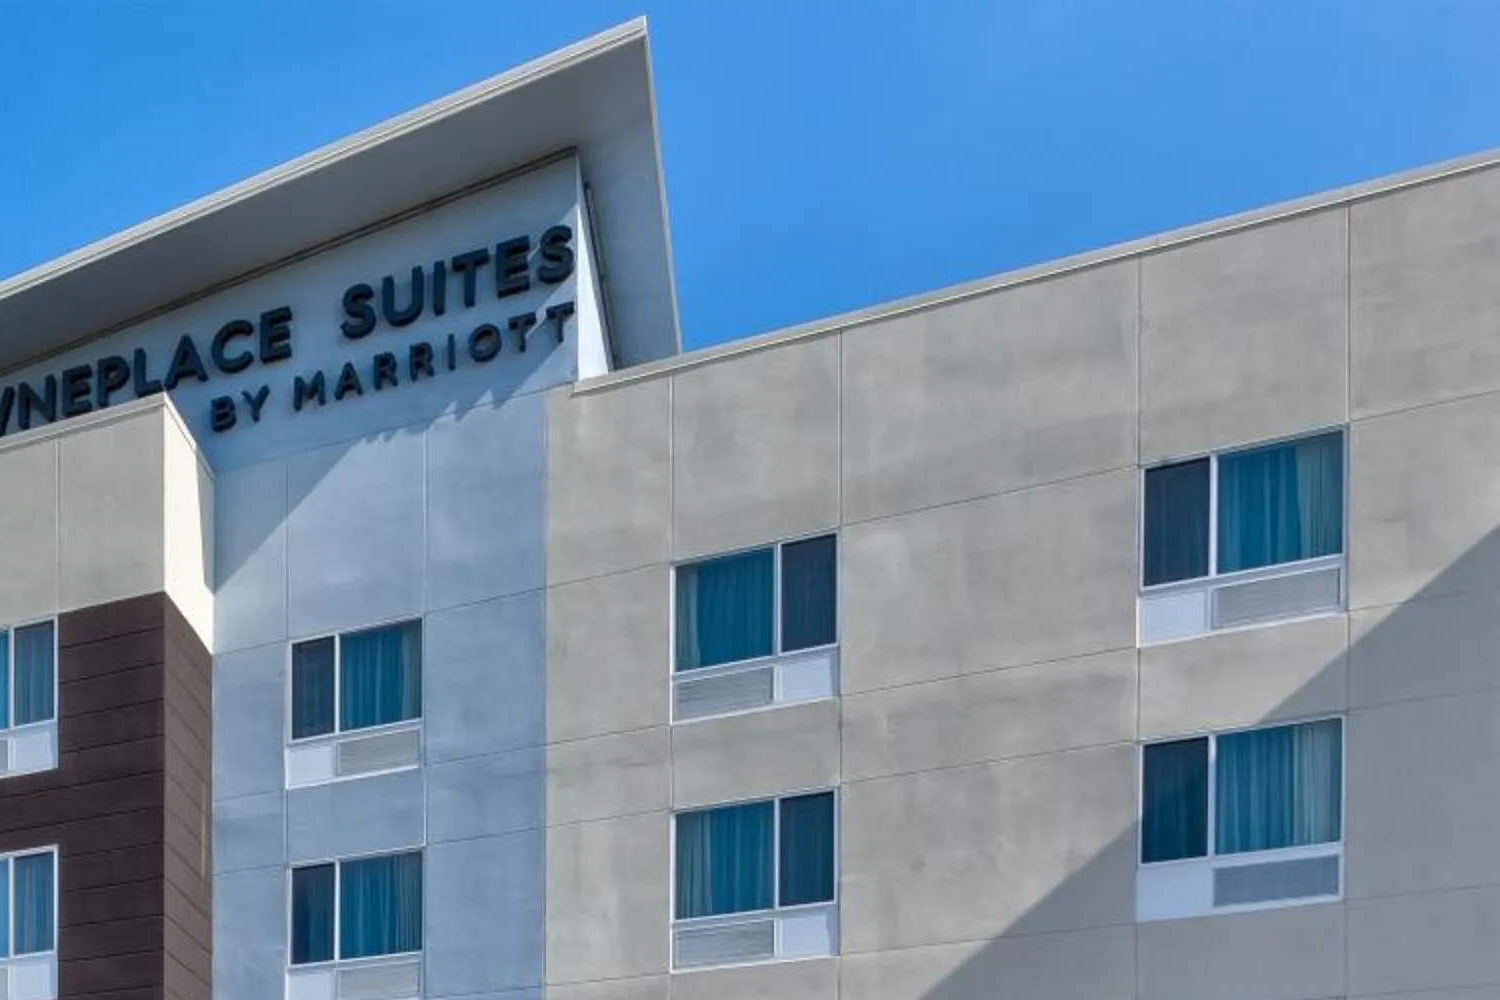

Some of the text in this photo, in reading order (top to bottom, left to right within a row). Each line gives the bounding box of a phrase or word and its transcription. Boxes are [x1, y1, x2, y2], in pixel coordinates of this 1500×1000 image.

[340, 225, 575, 339] SUITES
[210, 301, 575, 432] BY MARRIOTT
